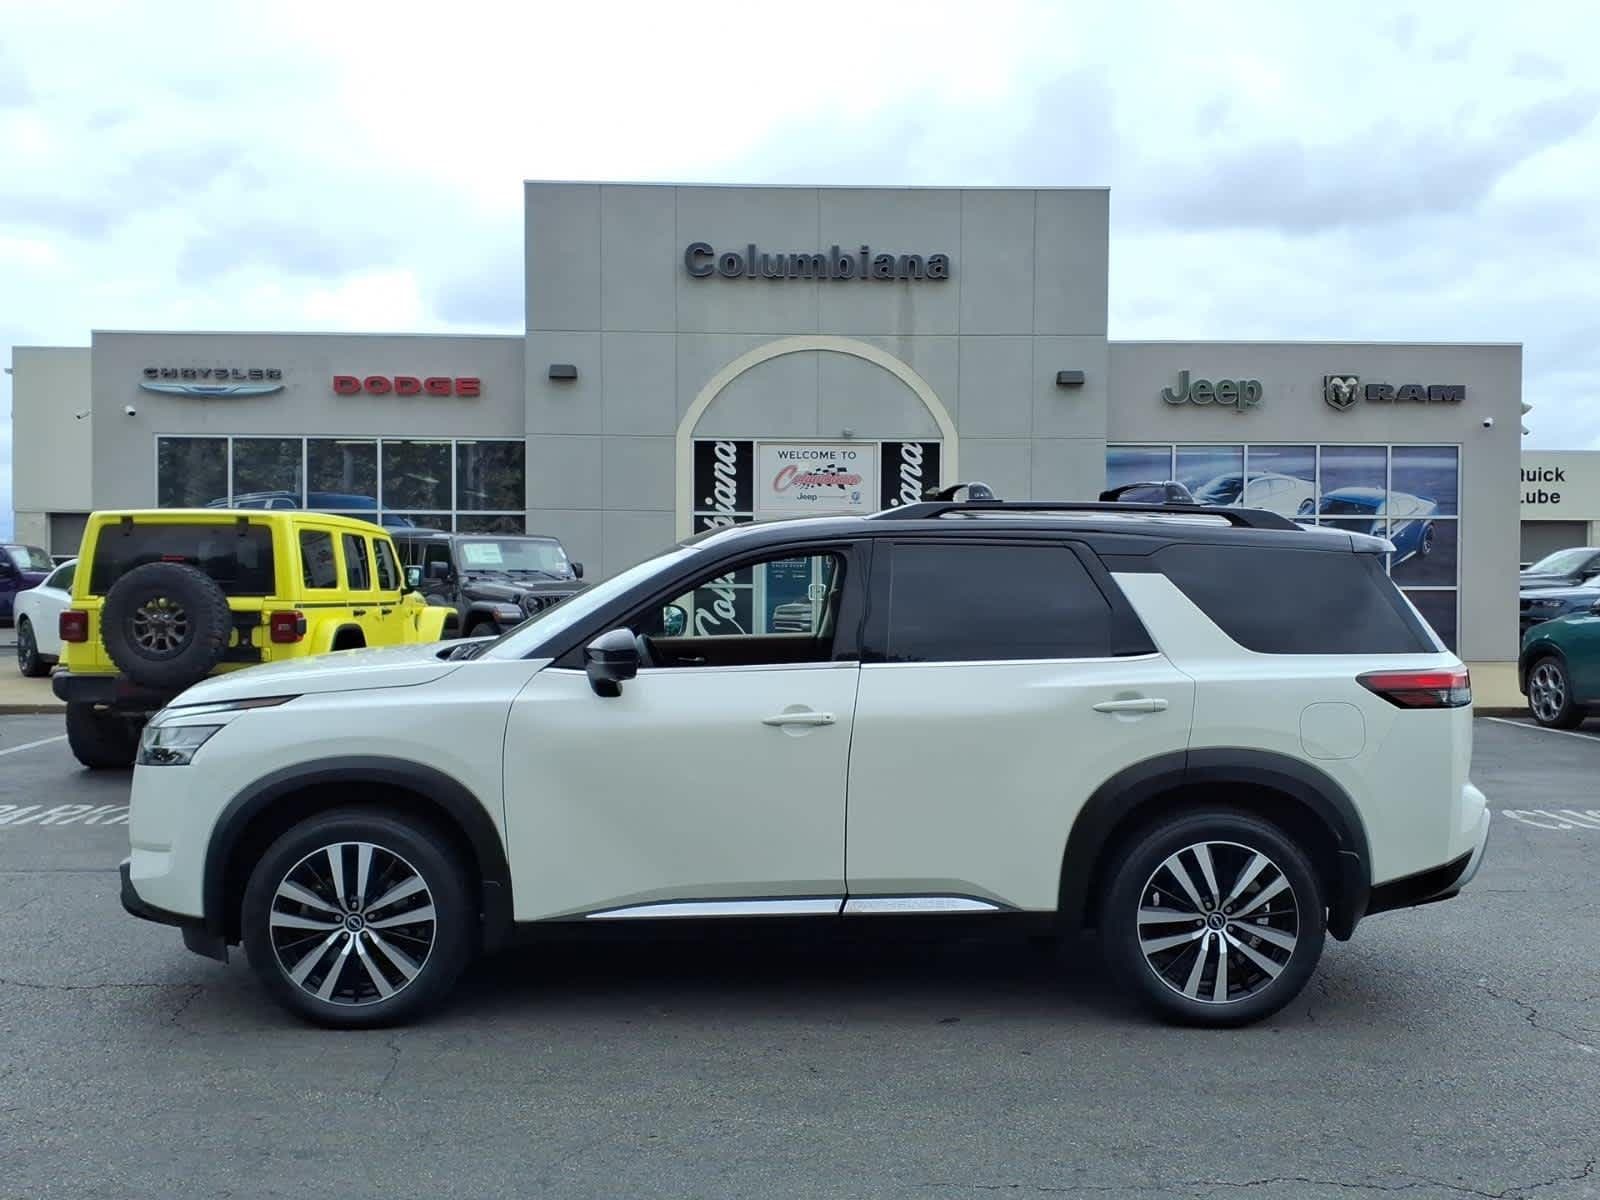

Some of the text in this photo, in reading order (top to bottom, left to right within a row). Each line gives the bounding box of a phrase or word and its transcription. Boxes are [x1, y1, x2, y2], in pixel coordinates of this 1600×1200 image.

[684, 241, 949, 279] Columbiana
[143, 368, 282, 380] CHRYSLER
[333, 375, 481, 396] DODGE
[1162, 370, 1263, 412] Jeep
[1366, 383, 1466, 402] RAM
[777, 450, 857, 460] WELCOME TO
